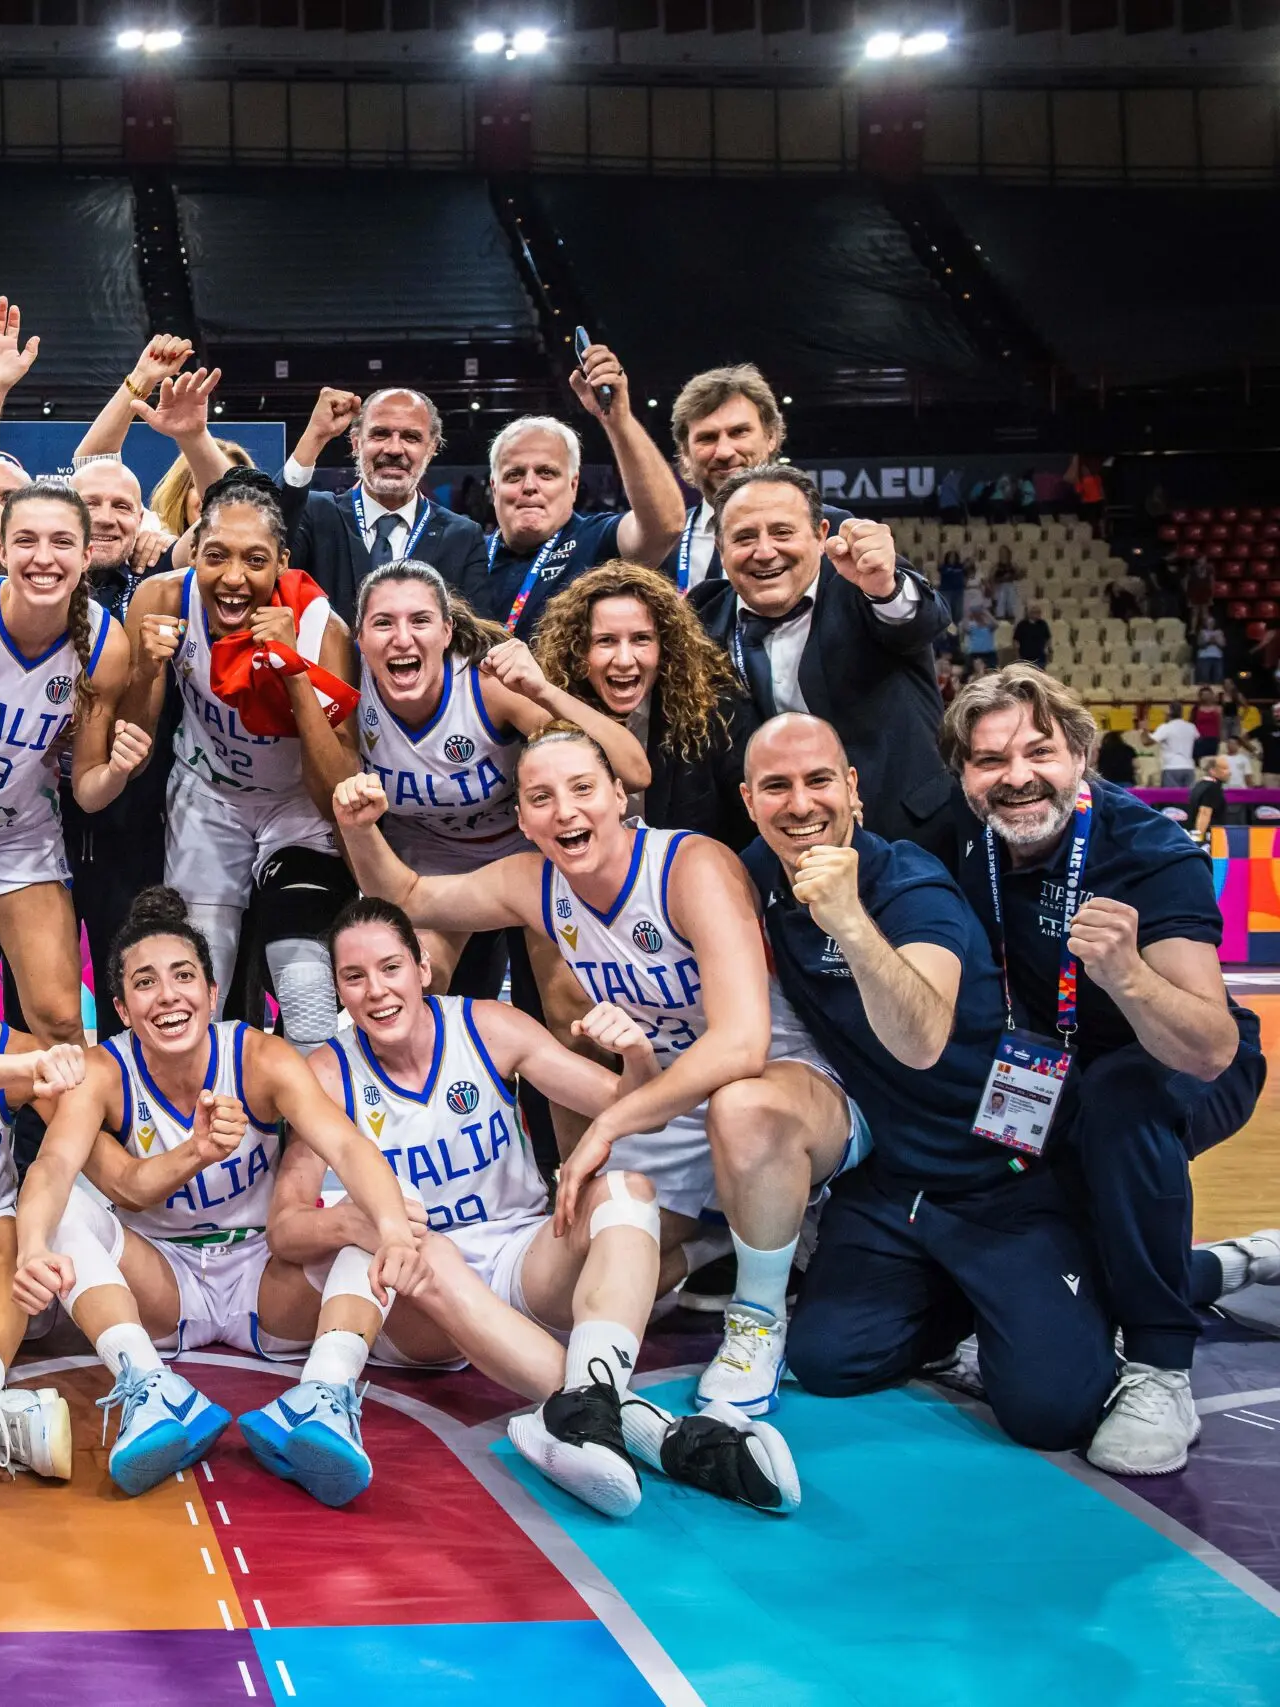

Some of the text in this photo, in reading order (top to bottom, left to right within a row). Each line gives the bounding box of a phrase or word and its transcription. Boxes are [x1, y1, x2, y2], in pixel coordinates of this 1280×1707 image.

[1070, 837, 1086, 869] DARE
[1067, 870, 1080, 888] TO
[566, 957, 701, 1010] TALIA
[166, 1143, 269, 1210] ALIA
